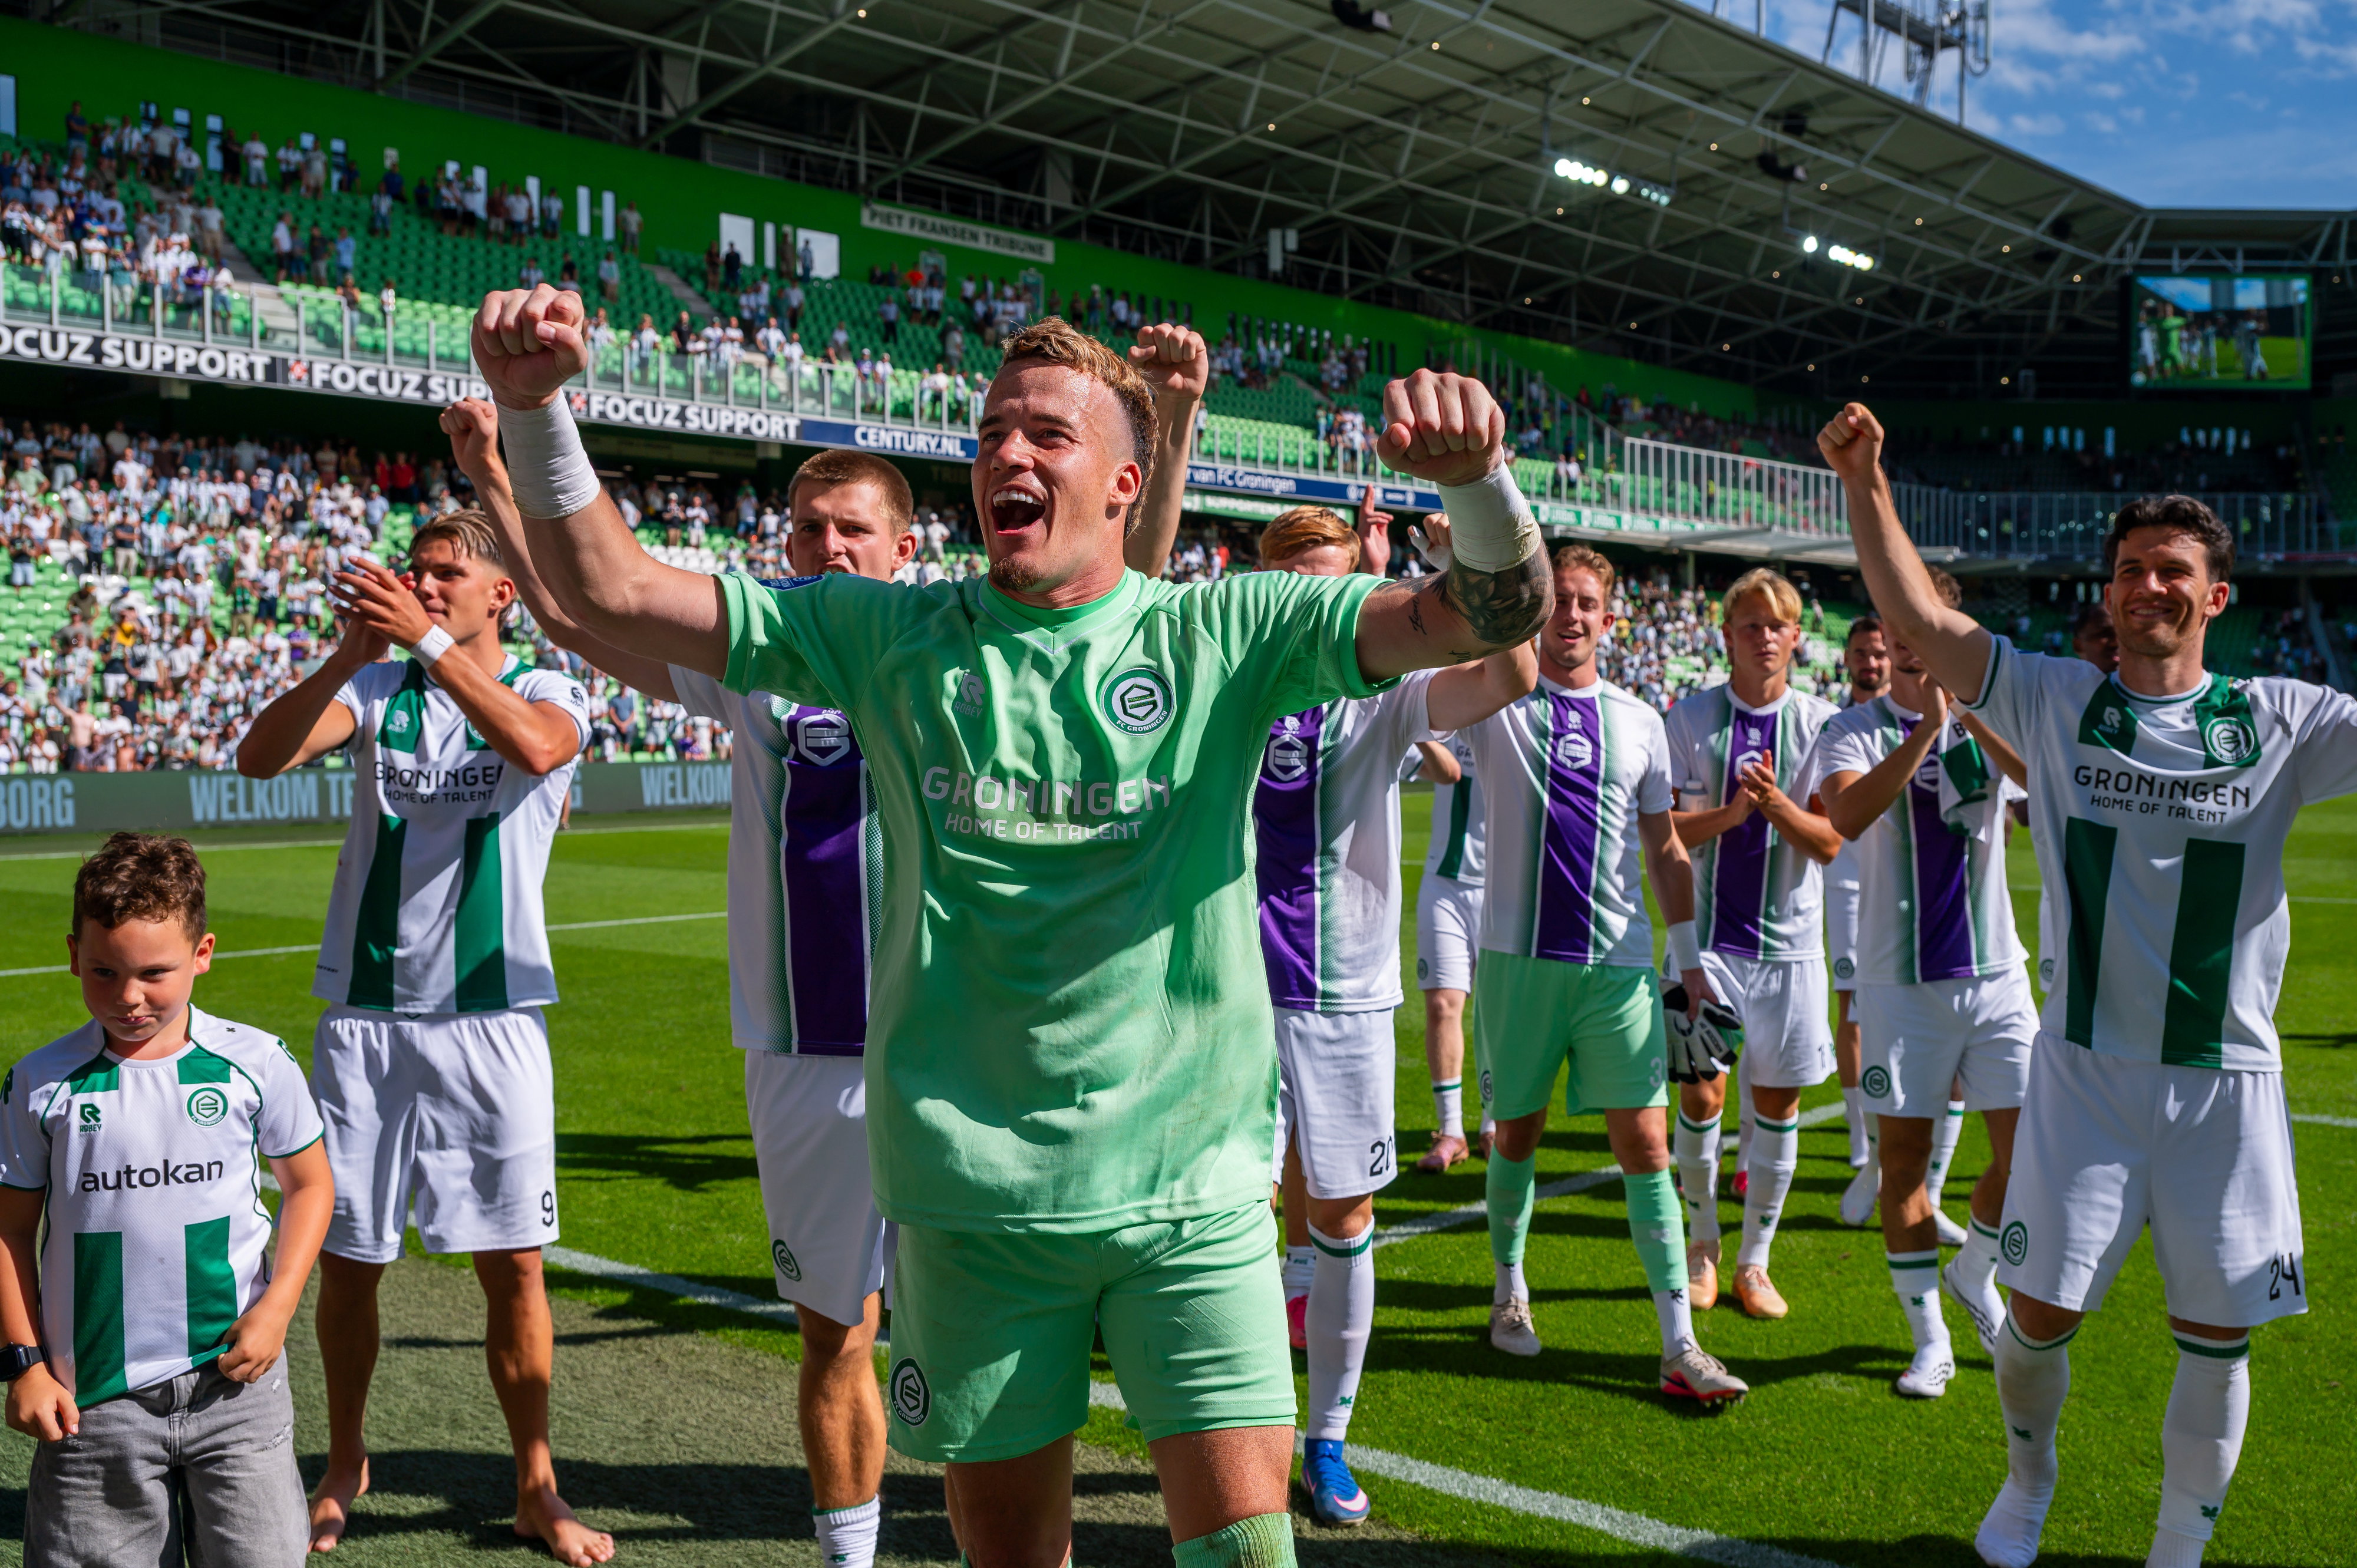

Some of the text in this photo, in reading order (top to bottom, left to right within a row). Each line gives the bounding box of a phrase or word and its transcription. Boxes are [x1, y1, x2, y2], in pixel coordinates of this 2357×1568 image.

[908, 213, 980, 243] FRANSEN
[101, 337, 272, 382] SUPPORT
[311, 361, 423, 400] FOCUZ
[589, 395, 801, 440] FOCUZ SUPPORT
[854, 426, 967, 457] CENTURY.NL
[1217, 468, 1234, 486] FC
[1234, 470, 1296, 495] Groningen
[953, 701, 982, 718] ROBEY
[1116, 710, 1168, 732] FC GRONINGEN
[0, 778, 75, 828] ORG
[189, 773, 319, 822] WELKOM
[384, 789, 417, 804] HOME
[420, 793, 438, 804] OF
[922, 765, 1170, 816] GRONINGEN
[2074, 765, 2250, 808] GRONINGEN
[2090, 794, 2227, 824] HOME OF TALENT
[944, 812, 1143, 840] HOME OF TALENT
[79, 1124, 102, 1133] ROBEY
[81, 1158, 223, 1193] autokan
[542, 1190, 554, 1227] 9
[2269, 1252, 2301, 1302] 24
